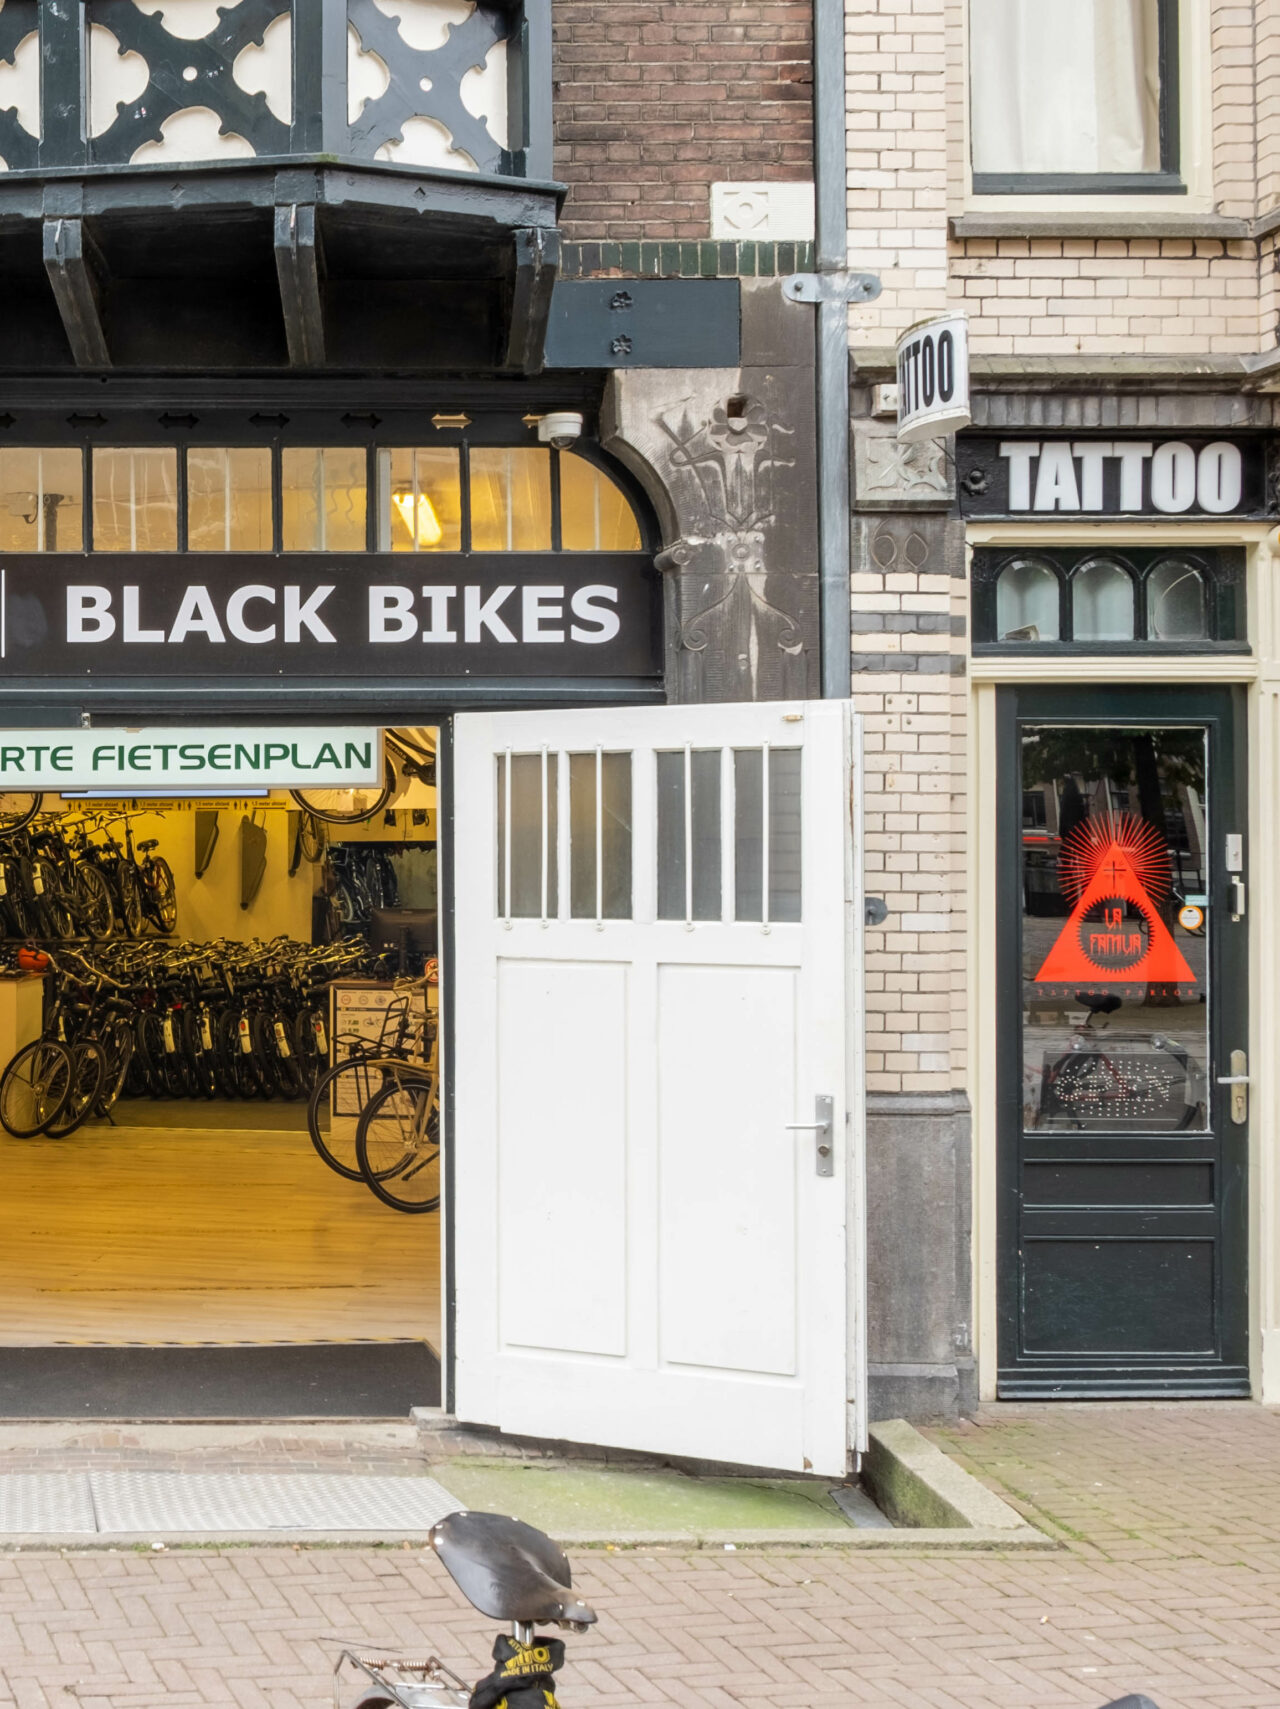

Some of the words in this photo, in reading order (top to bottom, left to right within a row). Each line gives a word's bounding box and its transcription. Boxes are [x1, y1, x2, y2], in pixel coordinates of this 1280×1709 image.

[999, 441, 1242, 513] TATTOO
[66, 584, 337, 644] BLACK
[369, 584, 621, 644] BIKES
[92, 742, 372, 771] FIETSENPLAN
[1037, 989, 1109, 997] TATTOO
[1057, 1075, 1173, 1102] OPEN
[522, 1665, 531, 1674] IN
[531, 1663, 554, 1673] ITALY
